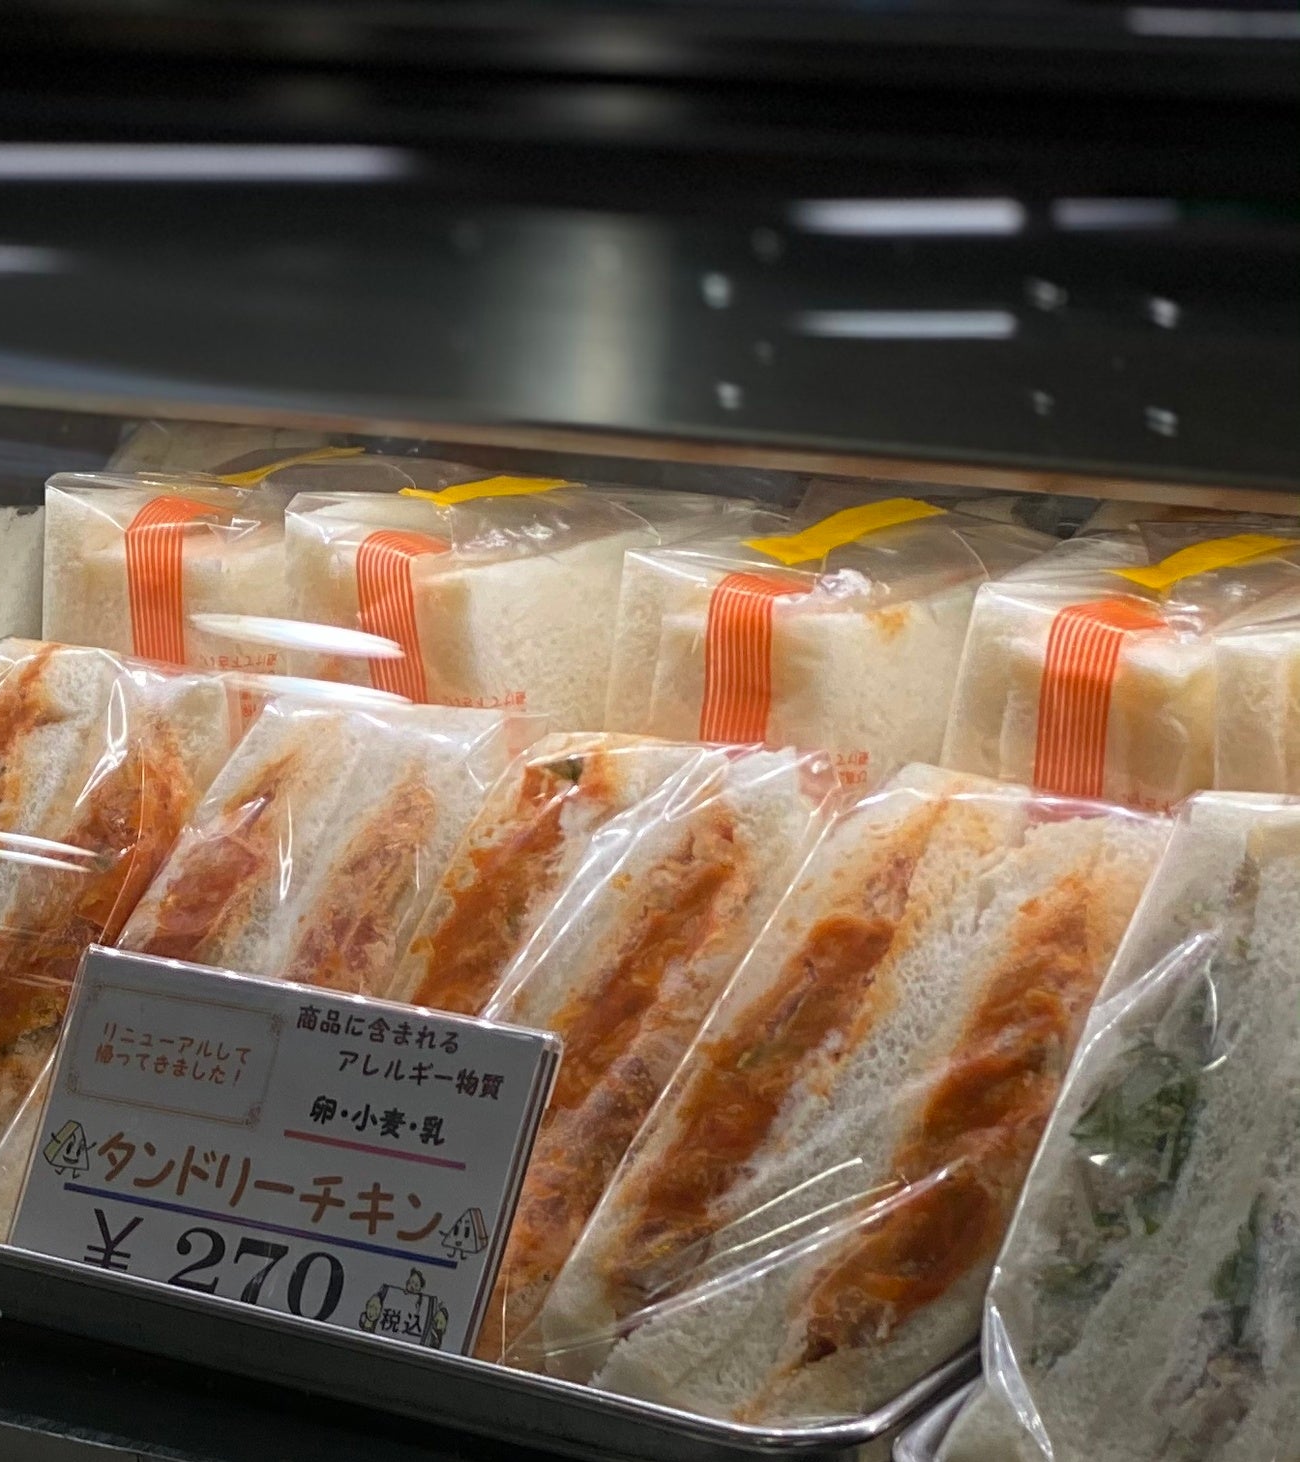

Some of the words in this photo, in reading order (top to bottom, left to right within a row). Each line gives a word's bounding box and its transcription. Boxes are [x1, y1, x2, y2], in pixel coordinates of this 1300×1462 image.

[102, 1021, 252, 1066] リニューアルして
[296, 1006, 459, 1055] 商品に含まれる
[337, 1050, 504, 1101] アレルギー物質
[309, 1095, 446, 1146] 卵・小麦・乳
[97, 1131, 443, 1243] タンドリーチキン
[380, 1308, 424, 1337] 税込
